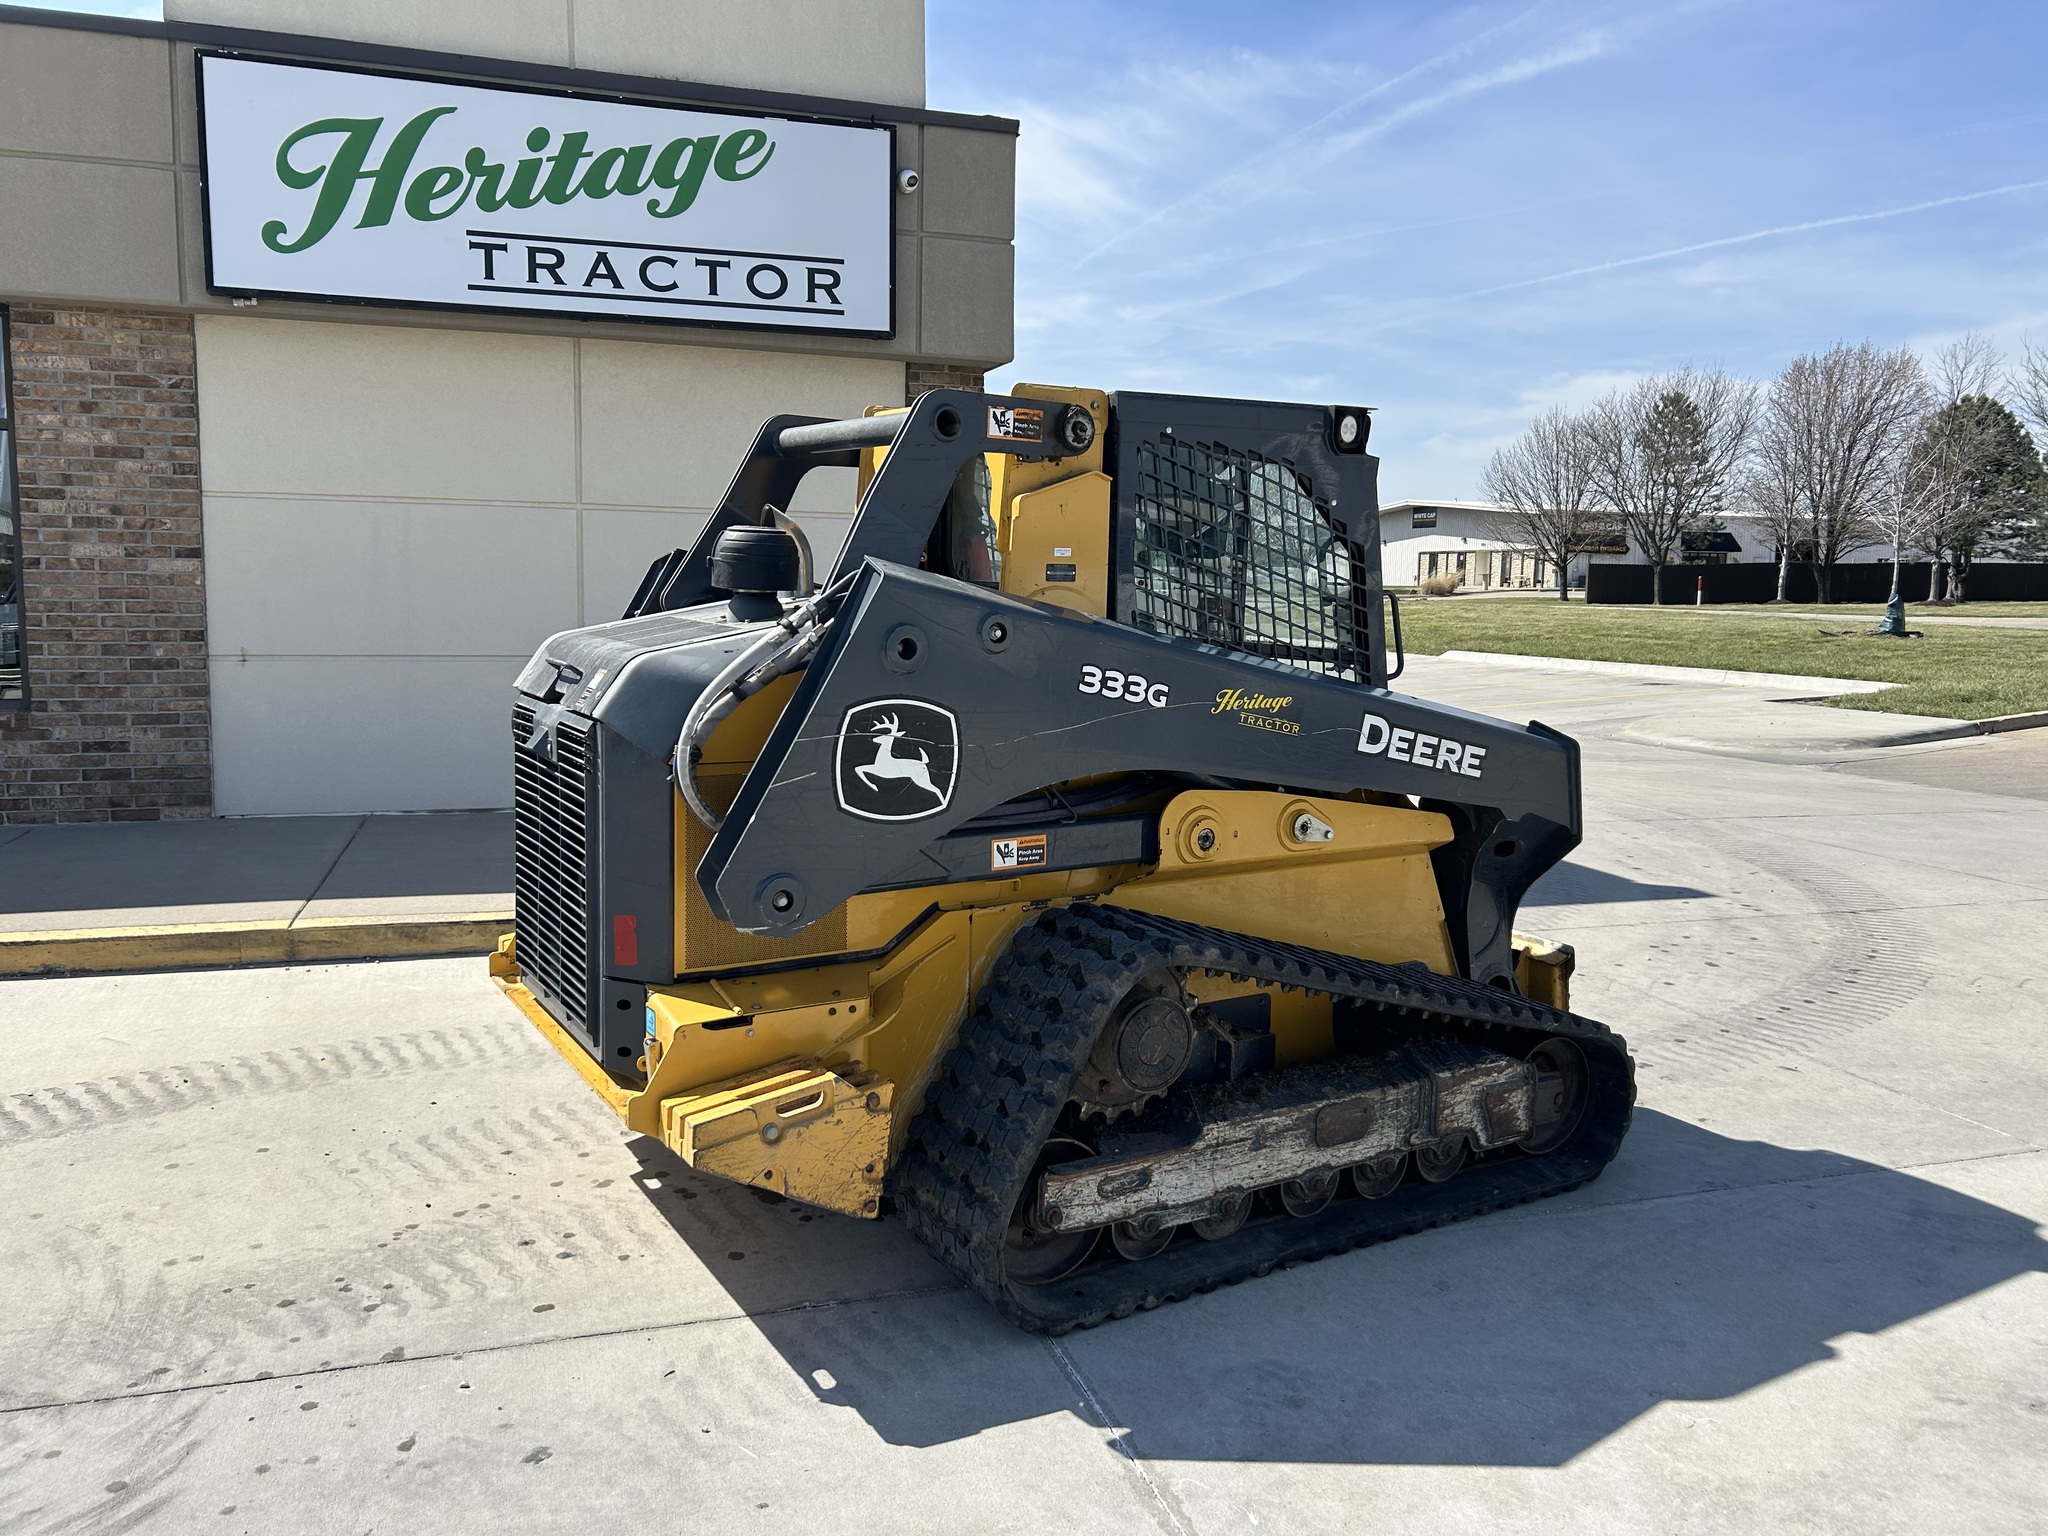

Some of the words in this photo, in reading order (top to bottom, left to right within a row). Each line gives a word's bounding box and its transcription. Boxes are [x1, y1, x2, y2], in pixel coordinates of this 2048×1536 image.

[261, 106, 777, 254] Heritage
[469, 241, 843, 306] TRACTOR
[1078, 665, 1170, 708] 333G
[1211, 688, 1293, 715] Heritage
[1239, 713, 1301, 735] TRACTOR
[1357, 713, 1487, 778] DEERE
